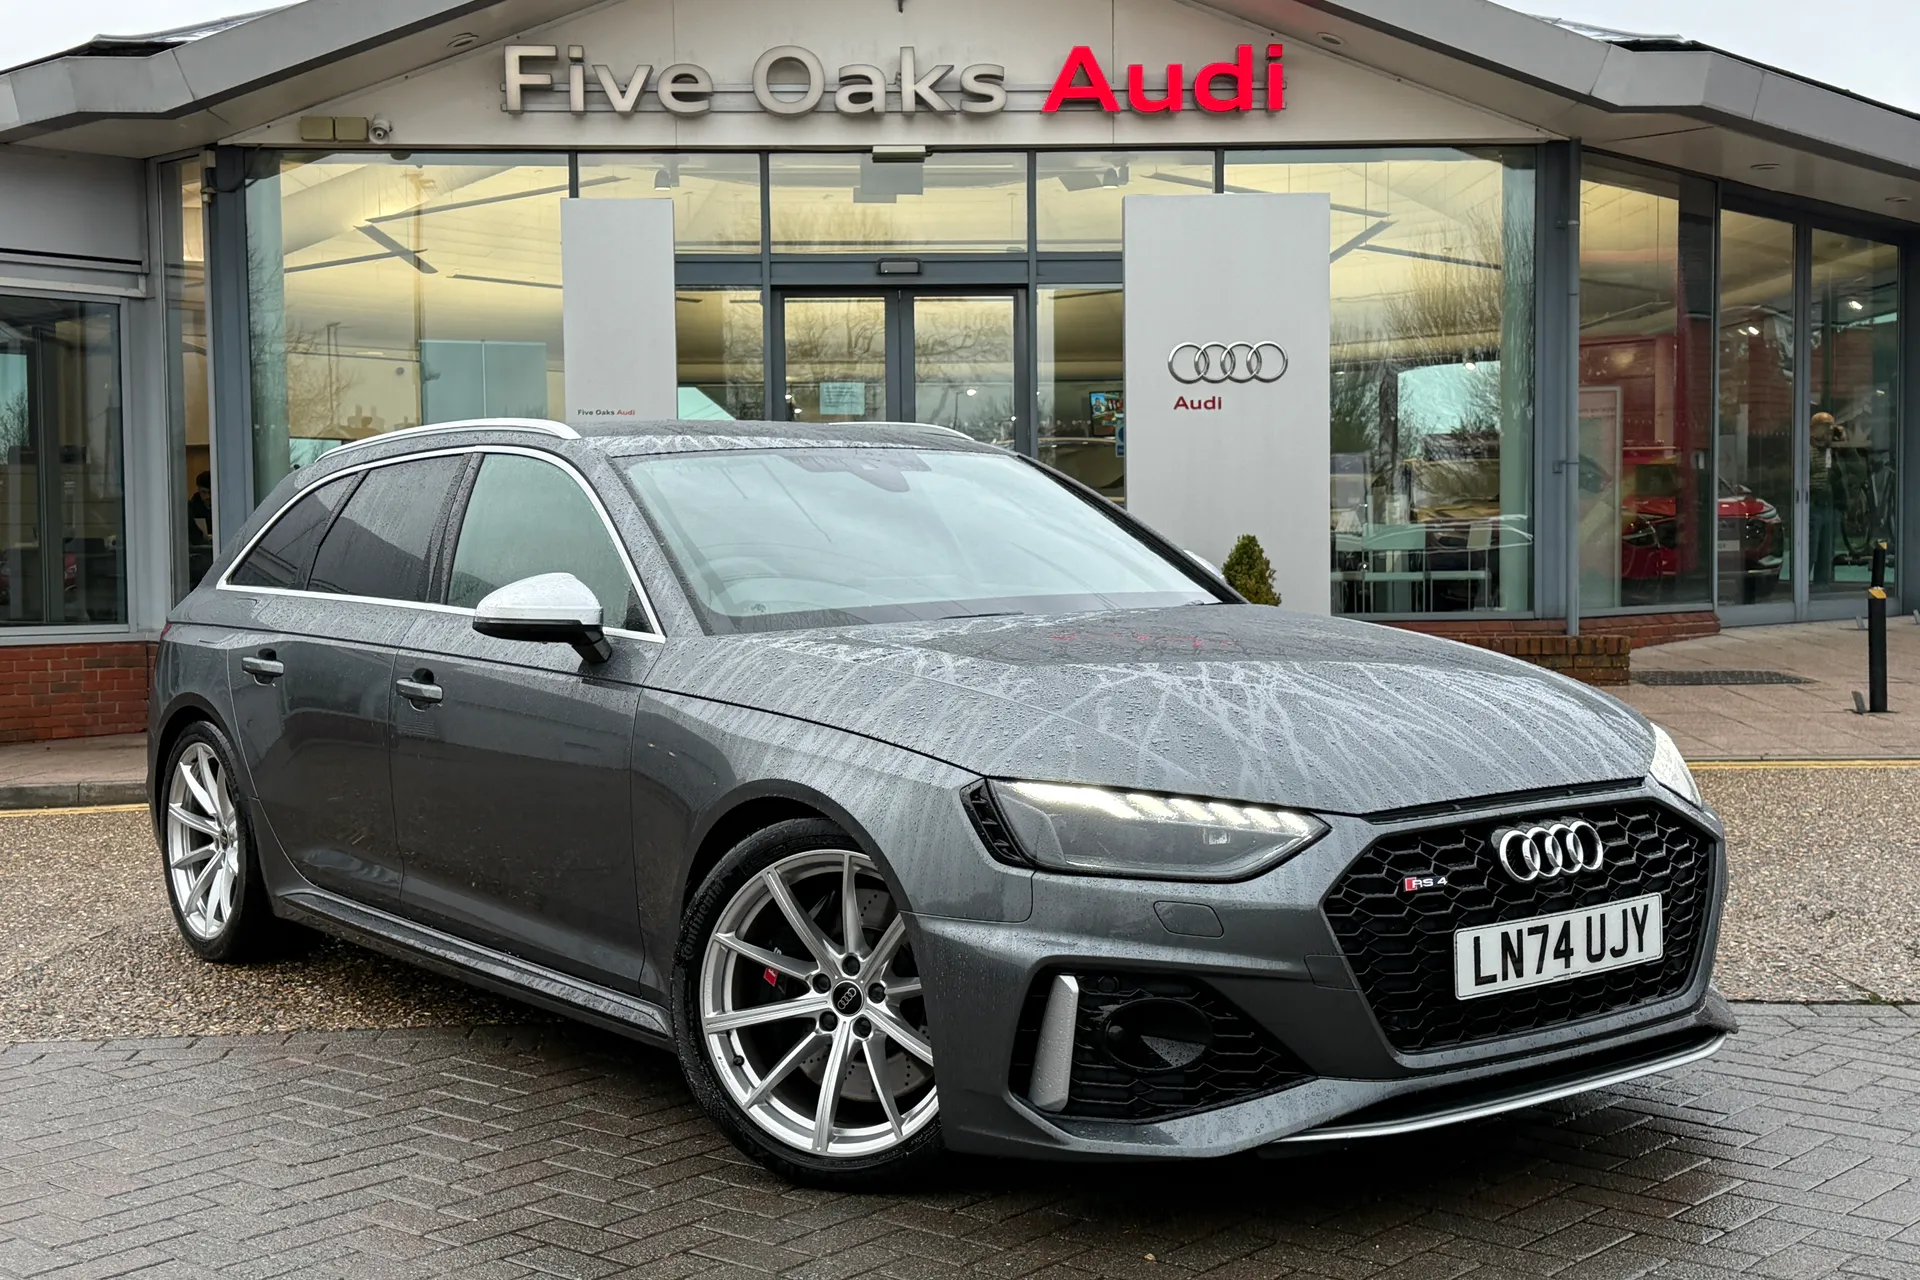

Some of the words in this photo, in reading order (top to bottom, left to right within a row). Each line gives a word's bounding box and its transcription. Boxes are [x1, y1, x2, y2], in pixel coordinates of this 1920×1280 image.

[504, 45, 713, 116] Five
[752, 45, 1007, 117] Oaks
[1041, 44, 1284, 114] Audi
[1173, 396, 1222, 410] Audi
[1473, 919, 1575, 987] LN74
[1585, 903, 1649, 964] UJY
